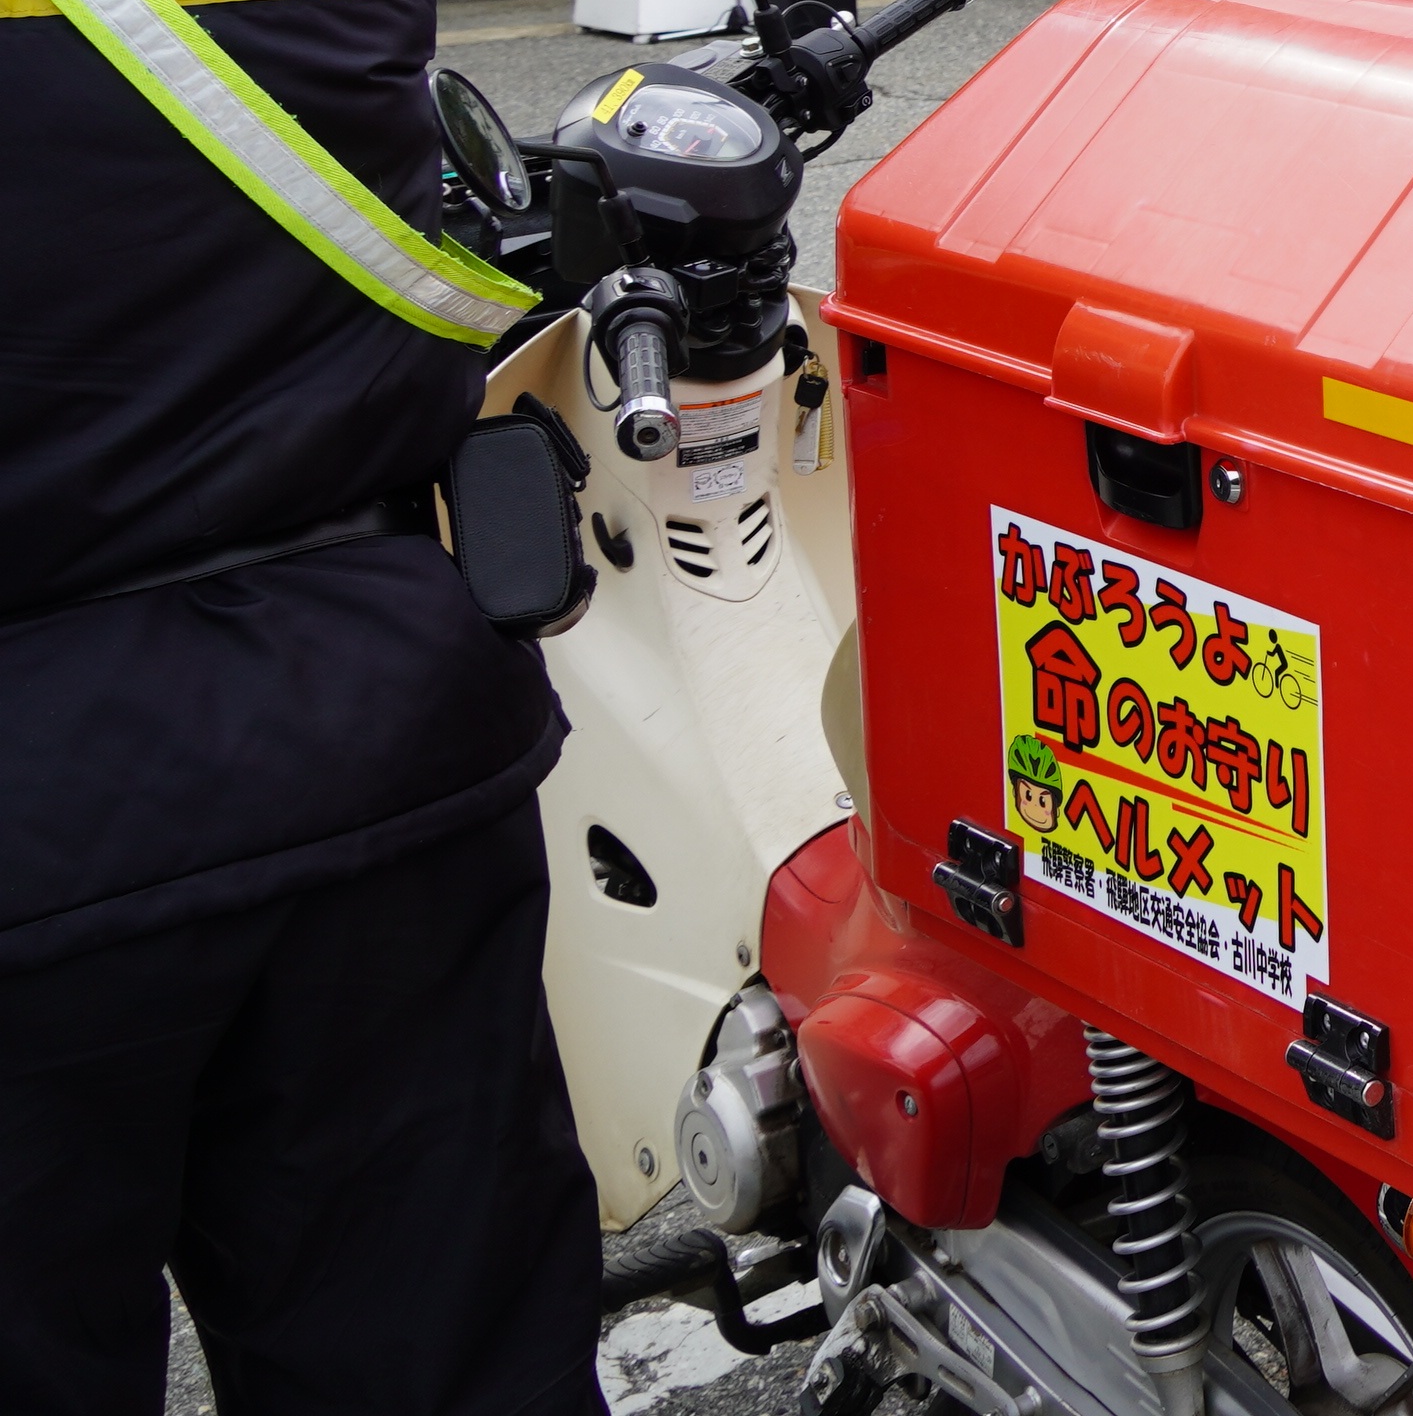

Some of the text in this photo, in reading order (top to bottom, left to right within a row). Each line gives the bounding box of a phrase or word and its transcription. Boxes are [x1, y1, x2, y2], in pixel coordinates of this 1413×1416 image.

[998, 523, 1251, 686] かぶろうよ
[1025, 620, 1310, 837] 命のお守り
[1064, 779, 1323, 951] ヘルメット
